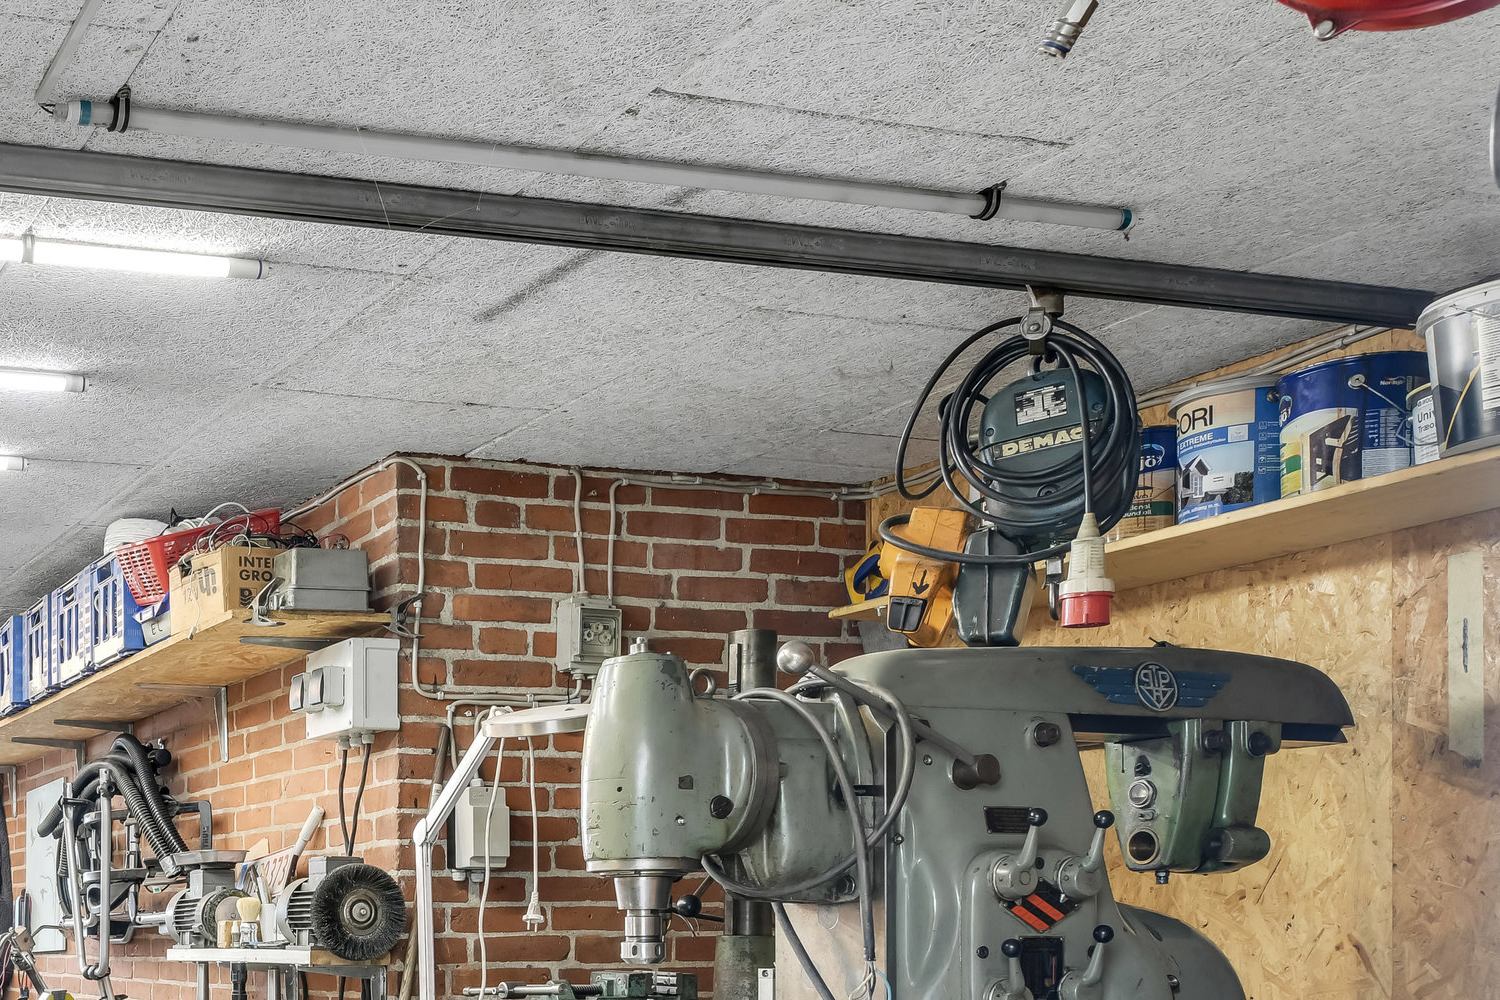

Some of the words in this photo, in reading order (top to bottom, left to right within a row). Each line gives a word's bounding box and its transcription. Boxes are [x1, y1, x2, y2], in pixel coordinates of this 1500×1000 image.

[1417, 408, 1433, 423] Uni
[1417, 422, 1435, 434] Træo
[1180, 432, 1214, 450] EXTREME
